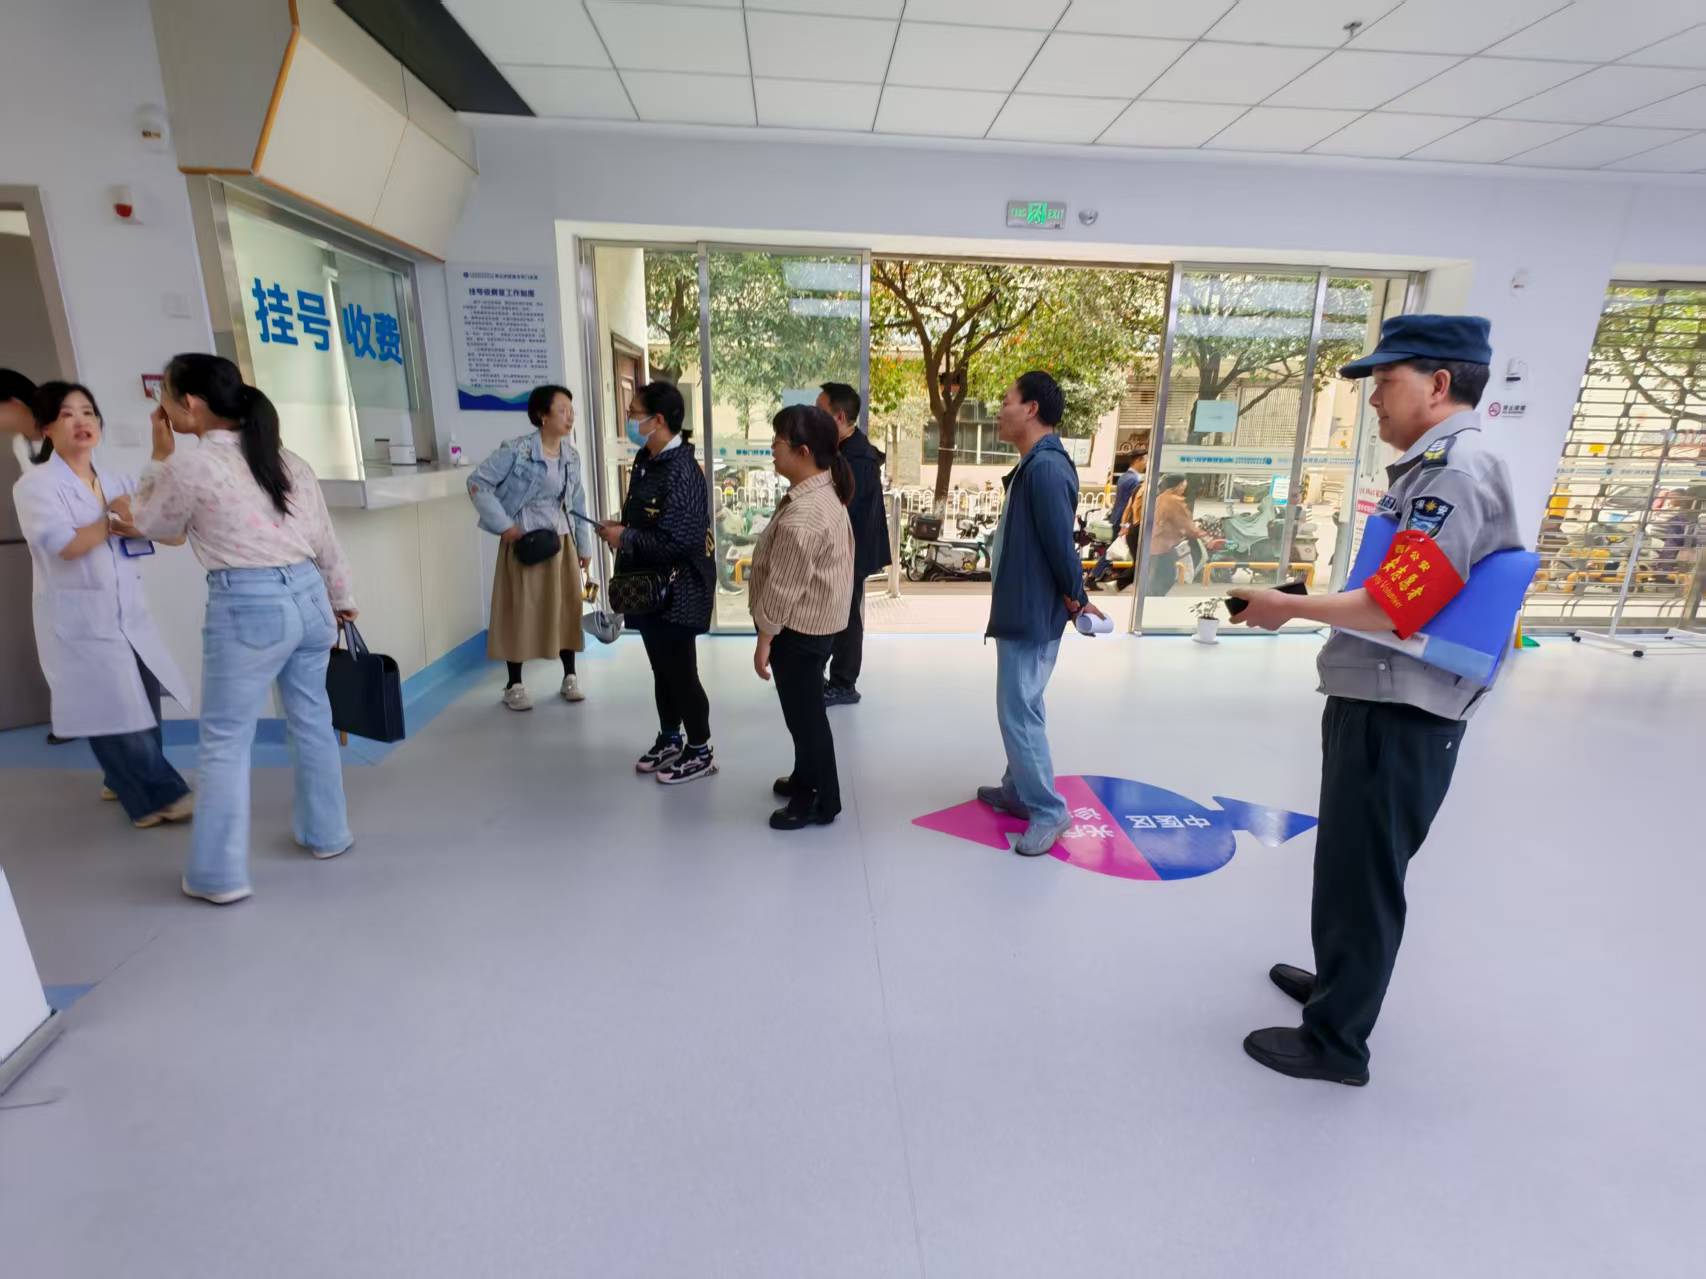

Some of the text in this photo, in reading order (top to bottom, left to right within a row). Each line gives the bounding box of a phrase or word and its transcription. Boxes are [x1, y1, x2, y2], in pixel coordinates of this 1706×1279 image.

[252, 276, 331, 352] 挂号
[342, 303, 403, 365] 收费
[1125, 814, 1211, 829] 中医区
